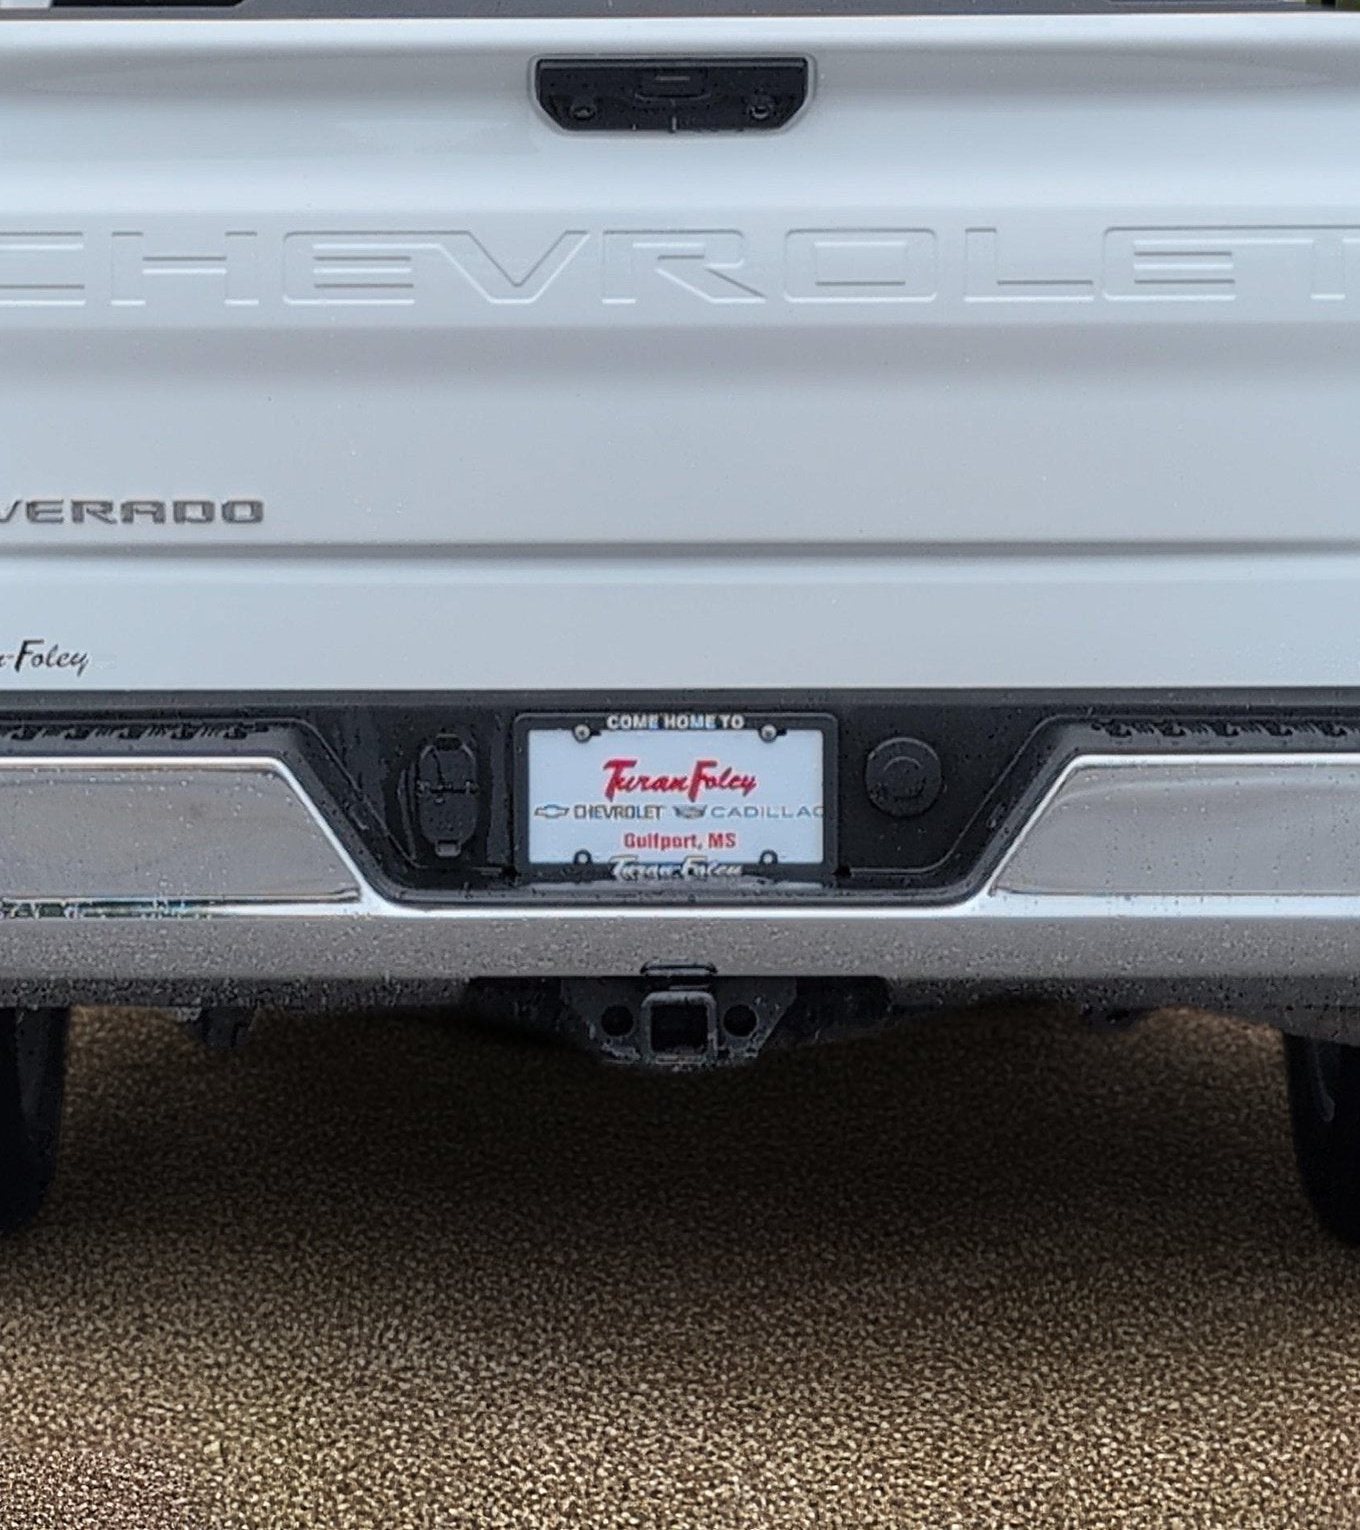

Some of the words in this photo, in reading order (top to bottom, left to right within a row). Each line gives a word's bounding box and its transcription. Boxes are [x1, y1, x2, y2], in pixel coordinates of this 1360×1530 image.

[606, 714, 659, 730] COME
[664, 714, 716, 730] HOME
[719, 714, 745, 730] TO
[573, 804, 663, 820] CHEVROLET
[710, 805, 823, 819] CADILLAC
[623, 832, 703, 851] Gulfport,
[708, 832, 737, 849] MS
